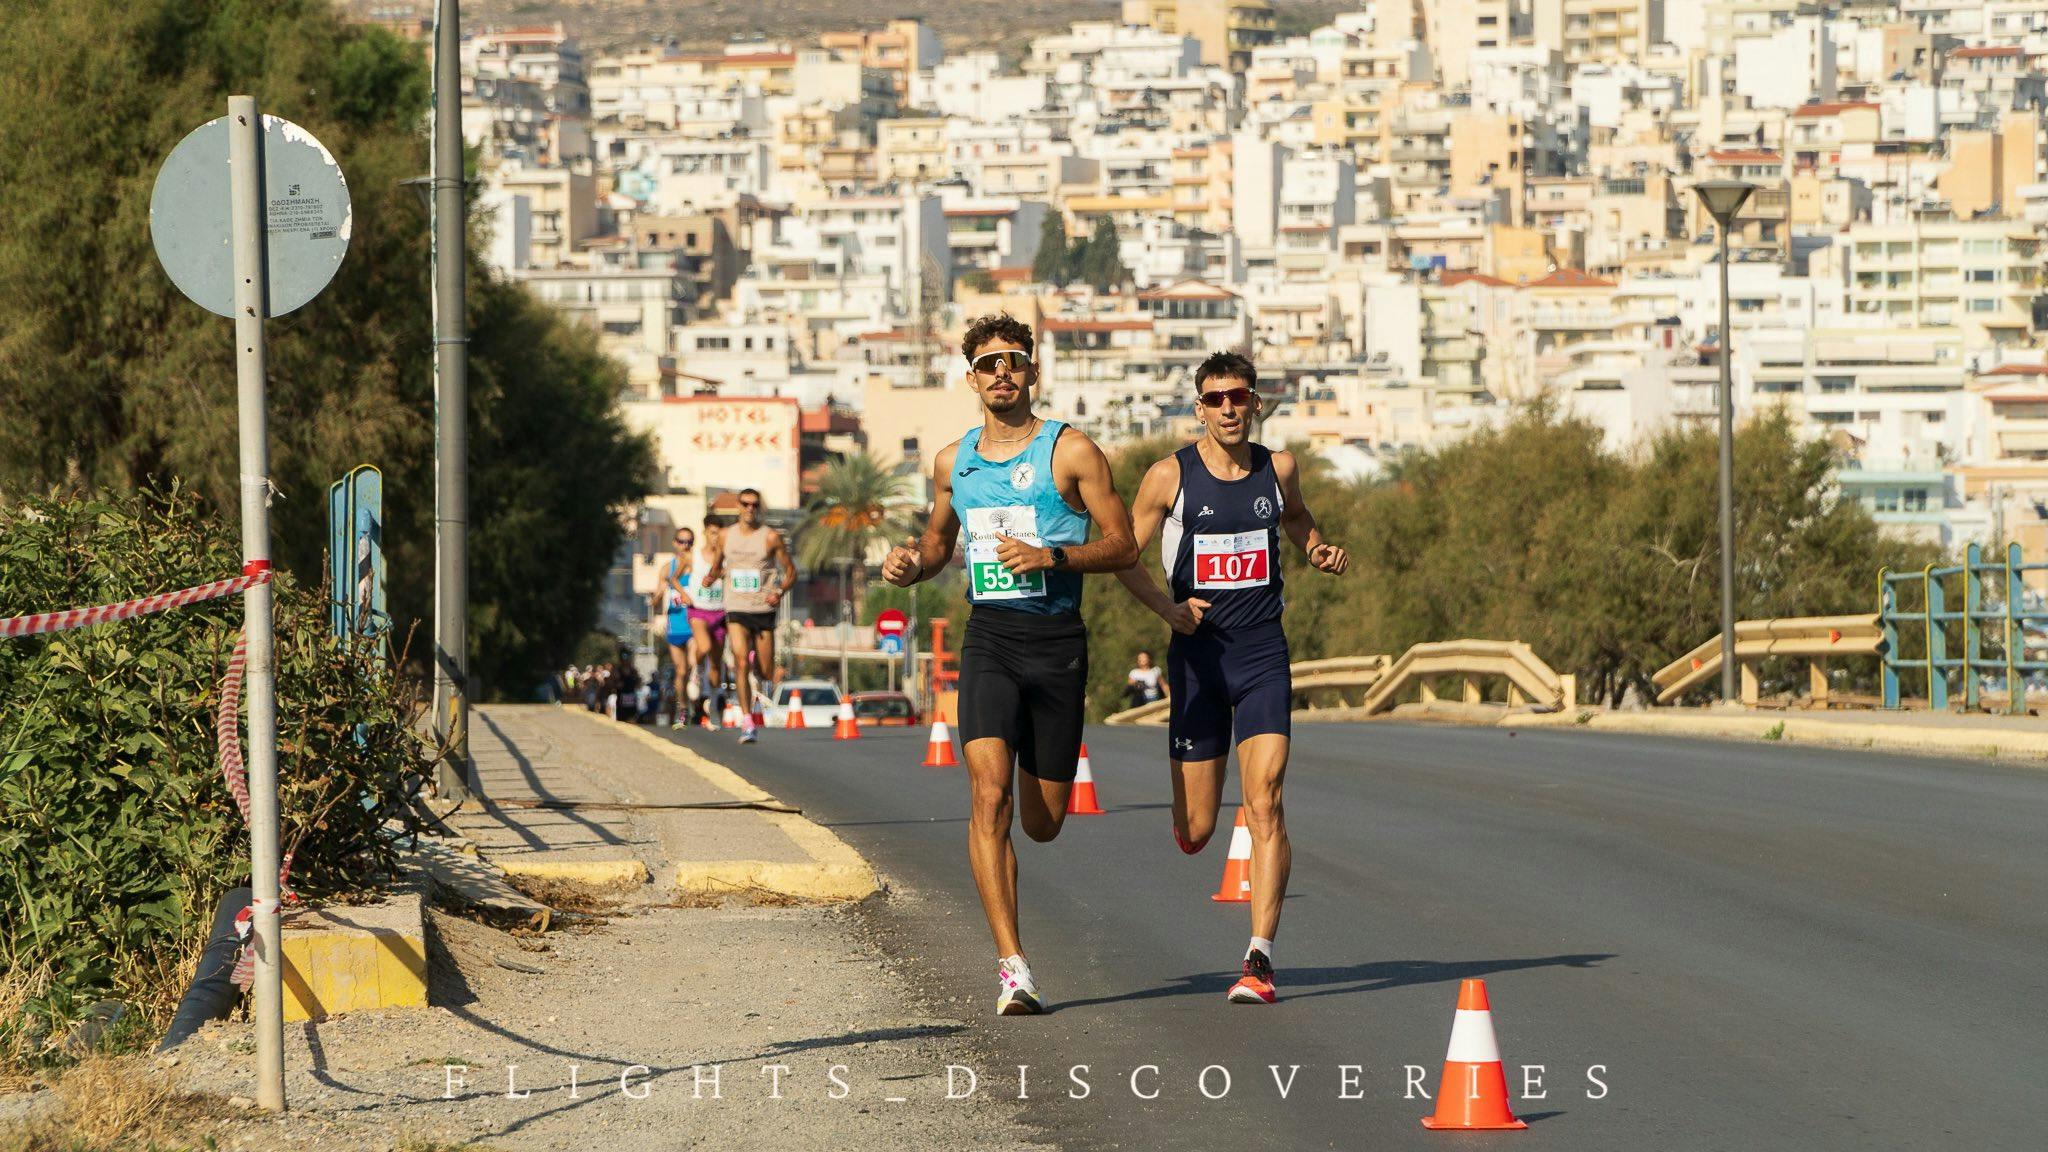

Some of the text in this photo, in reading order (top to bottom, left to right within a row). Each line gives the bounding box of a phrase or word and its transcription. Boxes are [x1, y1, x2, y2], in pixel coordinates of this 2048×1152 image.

[699, 407, 771, 424] HOTEL
[692, 432, 781, 452] ELYSEE
[1208, 553, 1258, 580] 107
